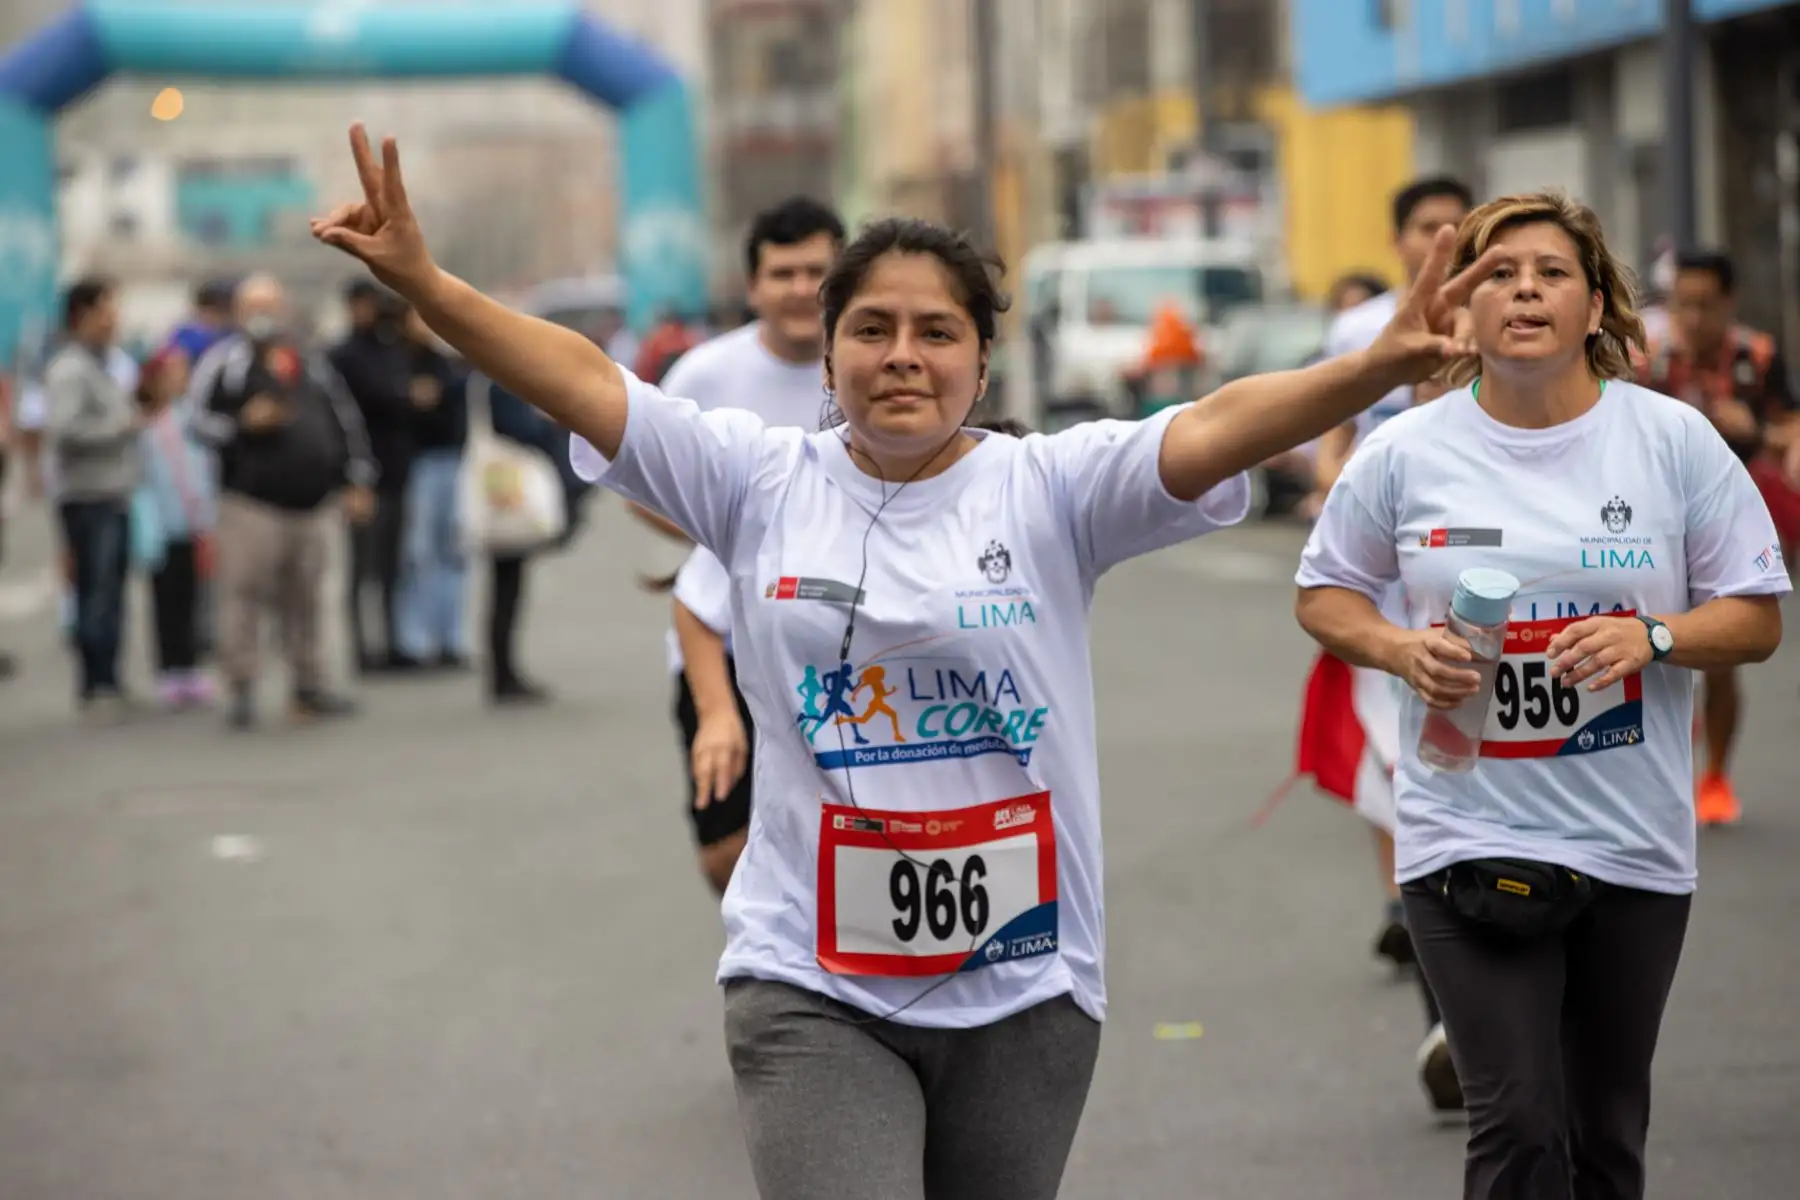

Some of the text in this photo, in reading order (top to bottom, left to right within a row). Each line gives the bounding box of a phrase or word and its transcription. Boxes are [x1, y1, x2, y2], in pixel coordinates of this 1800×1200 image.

[1580, 536, 1641, 545] MUNICIPALIDAD
[1581, 549, 1655, 569] LIMA
[958, 601, 1036, 629] LIMA
[907, 667, 1022, 707] LIMA
[1495, 661, 1580, 731] 956
[916, 702, 1048, 744] CORRE
[1602, 728, 1639, 746] LIMA
[855, 750, 876, 763] Por
[878, 749, 889, 761] la
[891, 743, 947, 760] donación
[890, 854, 989, 942] 966
[1011, 937, 1053, 957] LIMA
